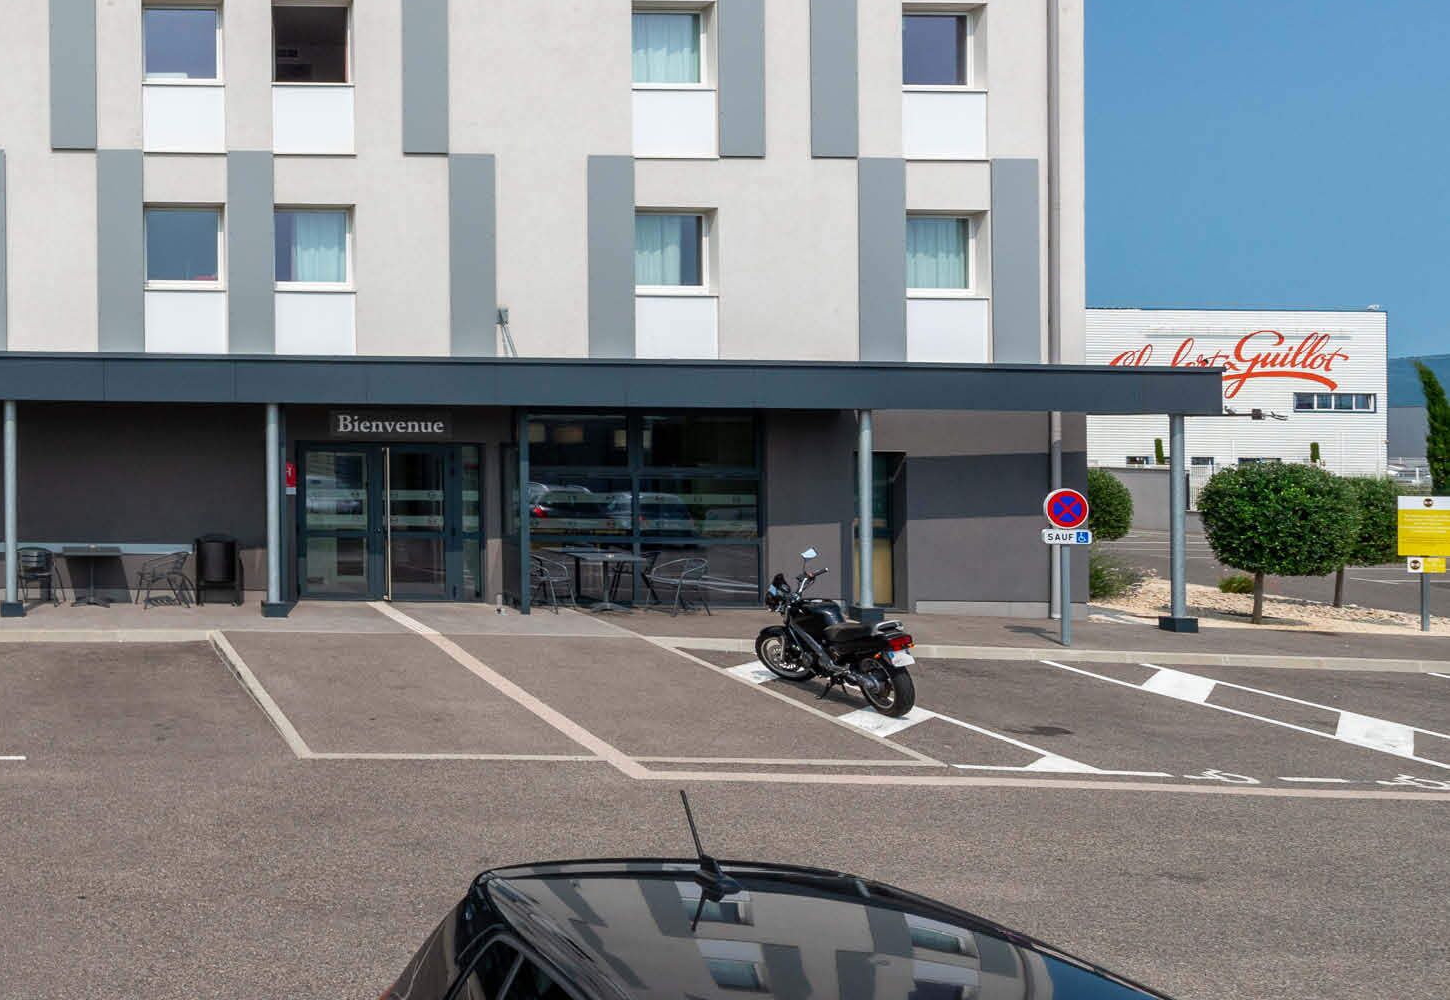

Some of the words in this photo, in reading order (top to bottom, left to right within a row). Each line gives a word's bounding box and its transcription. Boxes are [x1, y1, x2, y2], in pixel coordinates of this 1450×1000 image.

[1223, 330, 1351, 399] Guillot
[337, 414, 445, 433] Bienvenue
[1047, 533, 1074, 541] SAUF
